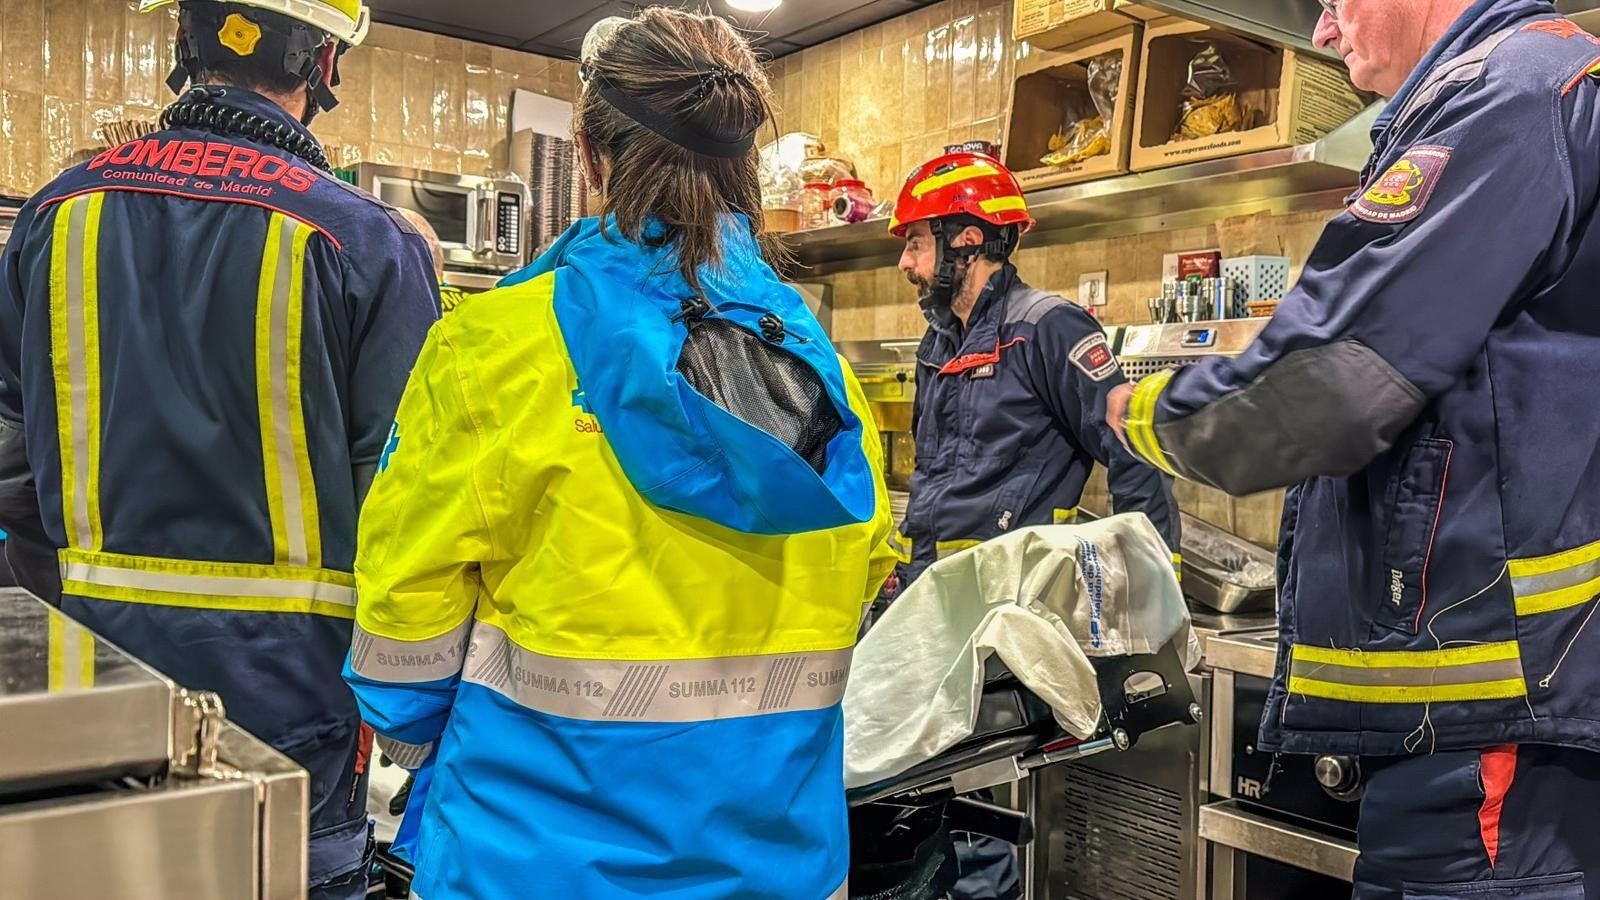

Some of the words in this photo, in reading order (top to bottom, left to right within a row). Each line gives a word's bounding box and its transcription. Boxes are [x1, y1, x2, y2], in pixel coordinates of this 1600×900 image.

[102, 168, 188, 187] Comunidad
[194, 181, 214, 190] de
[220, 181, 273, 198] Madrid
[574, 418, 603, 433] Salu
[376, 651, 447, 667] SUMMA
[515, 666, 570, 695] SUMMA
[574, 681, 605, 698] 112
[669, 679, 728, 699] SUMMA
[730, 677, 756, 694] 112
[1237, 776, 1261, 800] HR
